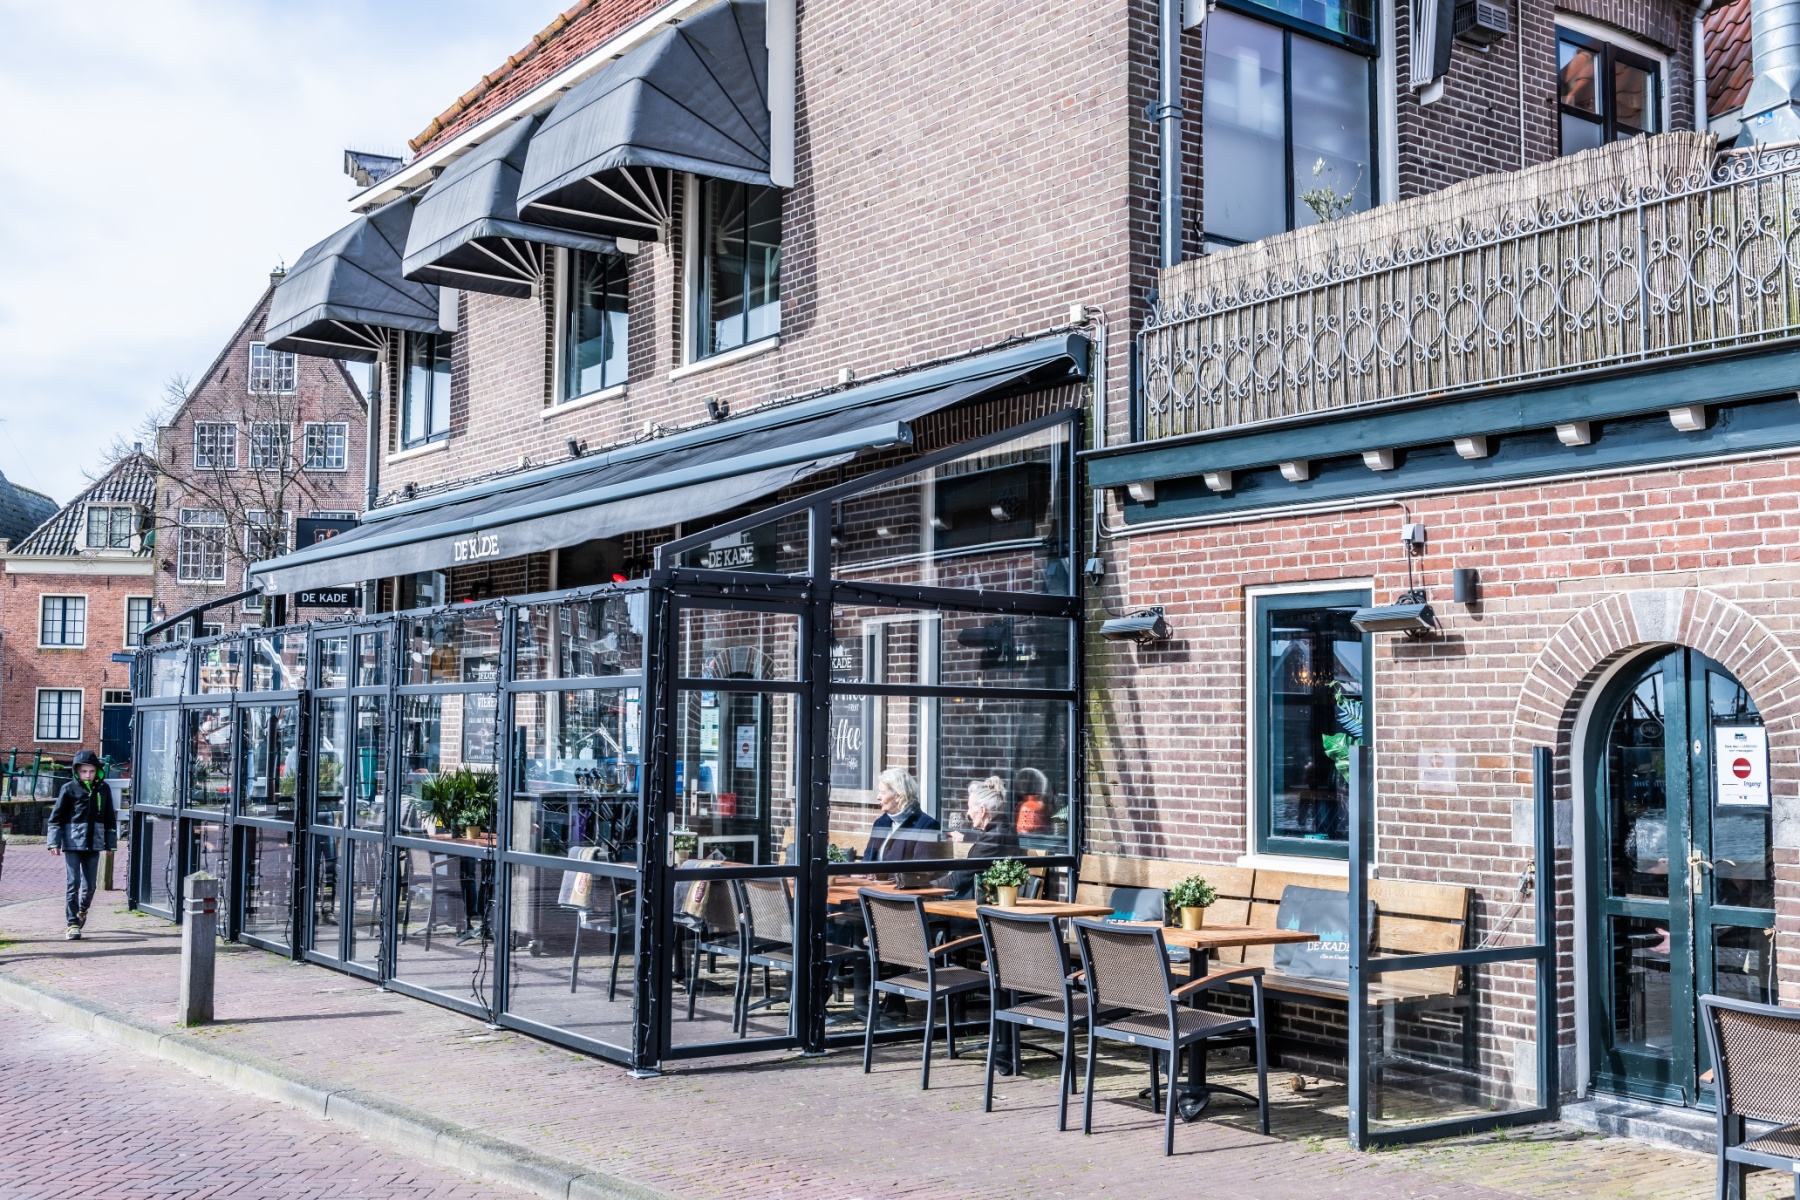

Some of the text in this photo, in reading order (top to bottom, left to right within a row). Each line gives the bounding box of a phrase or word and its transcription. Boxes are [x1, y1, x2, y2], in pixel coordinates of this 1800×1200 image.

[454, 540, 468, 562] DE
[708, 545, 754, 569] DE KADE
[301, 593, 348, 603] DE KADE
[831, 657, 852, 669] KADE
[1306, 941, 1350, 952] DE KAD
